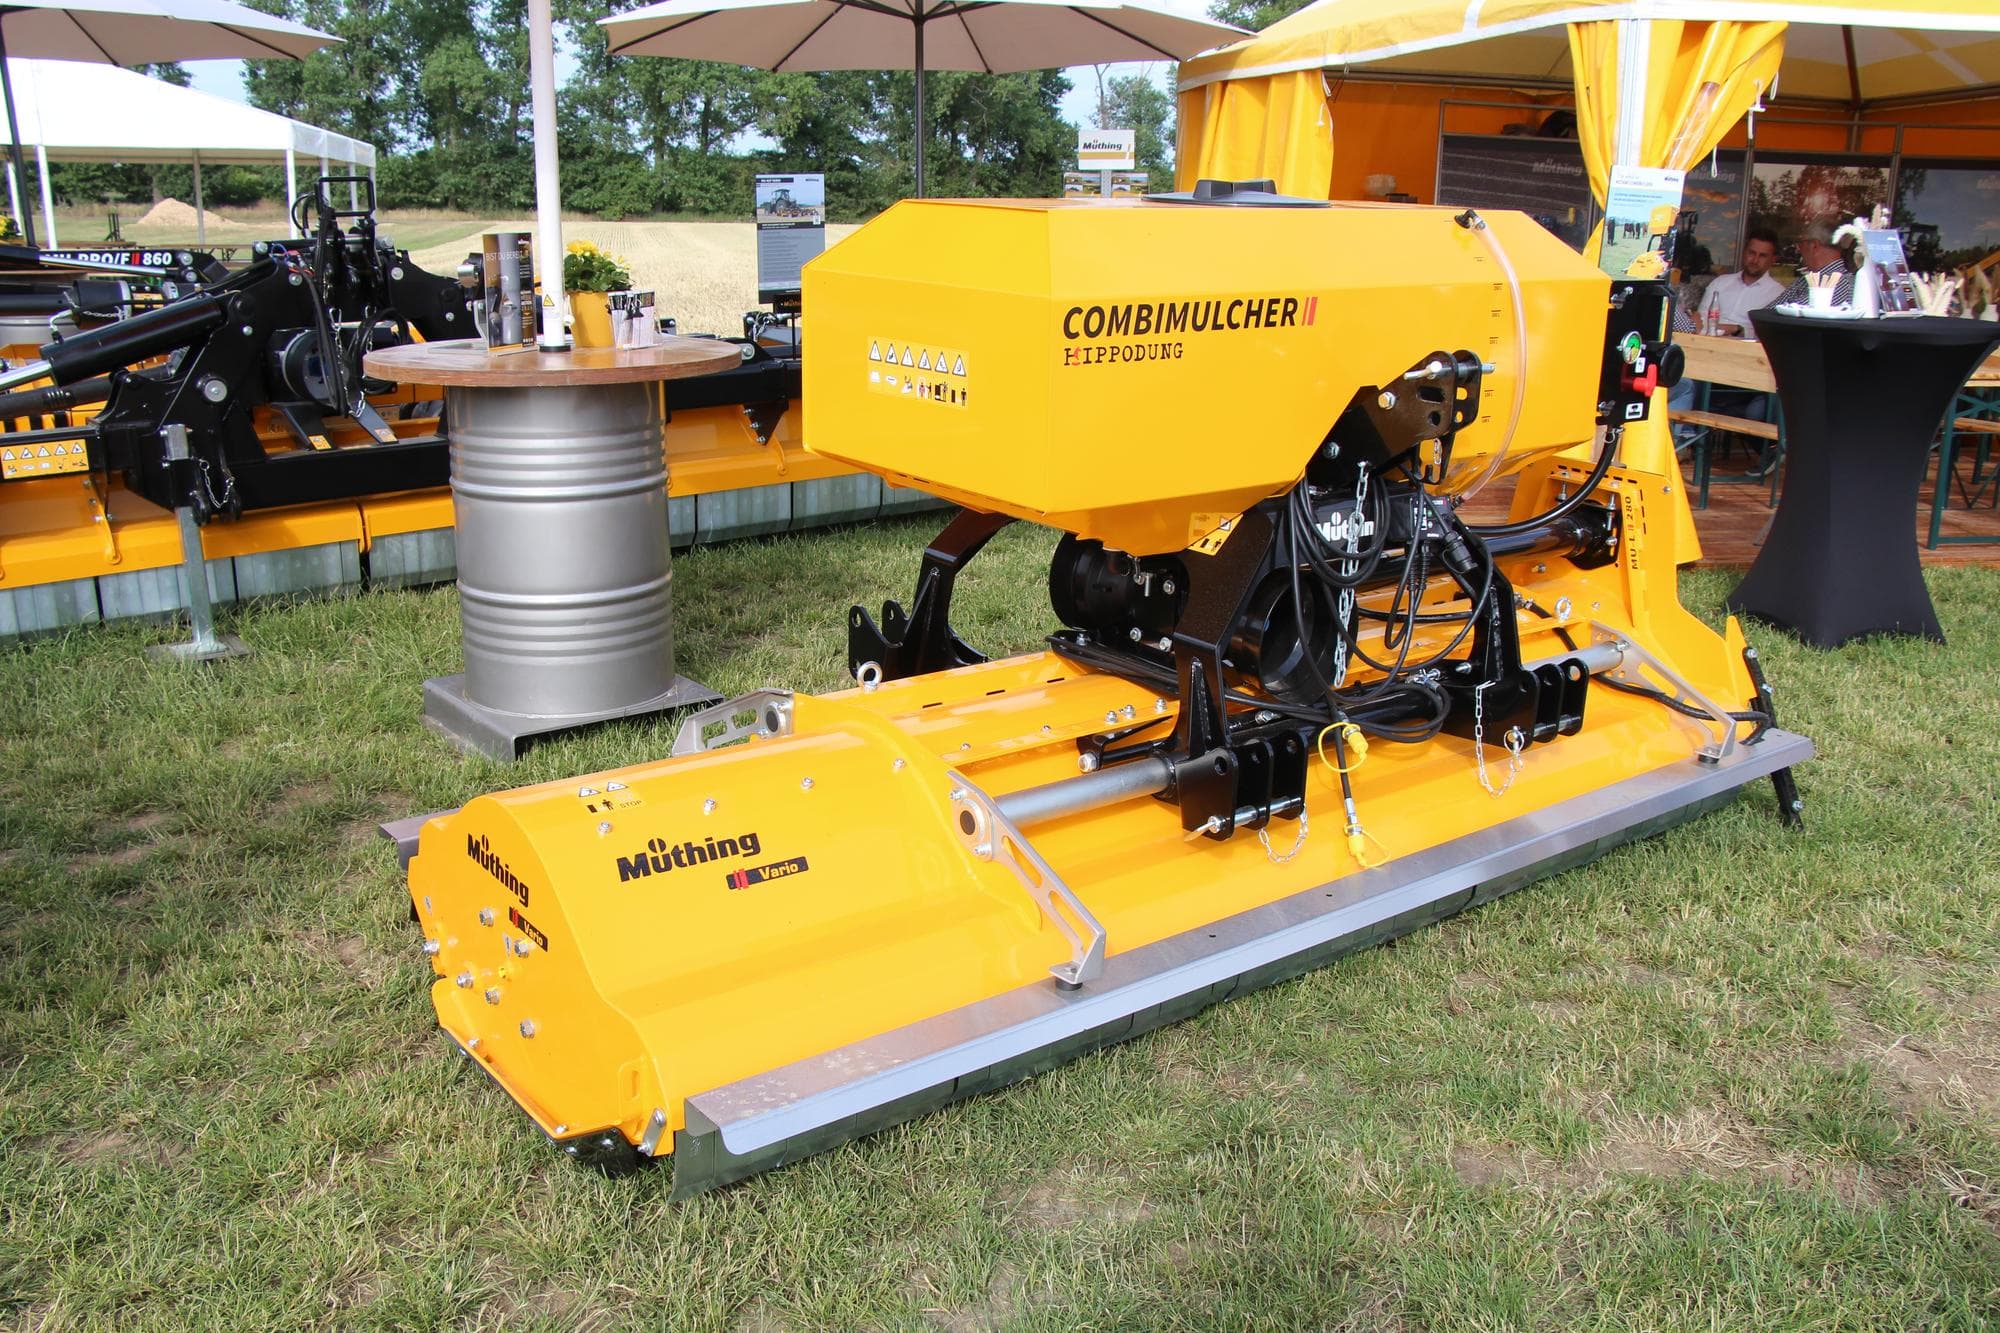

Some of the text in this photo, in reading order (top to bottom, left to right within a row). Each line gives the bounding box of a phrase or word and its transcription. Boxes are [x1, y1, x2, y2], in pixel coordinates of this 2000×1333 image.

[1083, 139, 1122, 150] Müthing
[142, 252, 172, 266] 860
[1063, 297, 1299, 340] COMBIMULCHER
[1063, 342, 1184, 367] HIPPODUNG
[1624, 496, 1634, 521] 280
[619, 799, 642, 809] STOP
[616, 832, 762, 882] Müthing
[467, 833, 529, 908] Müthing
[758, 862, 799, 881] Vario
[523, 920, 543, 946] Vario
